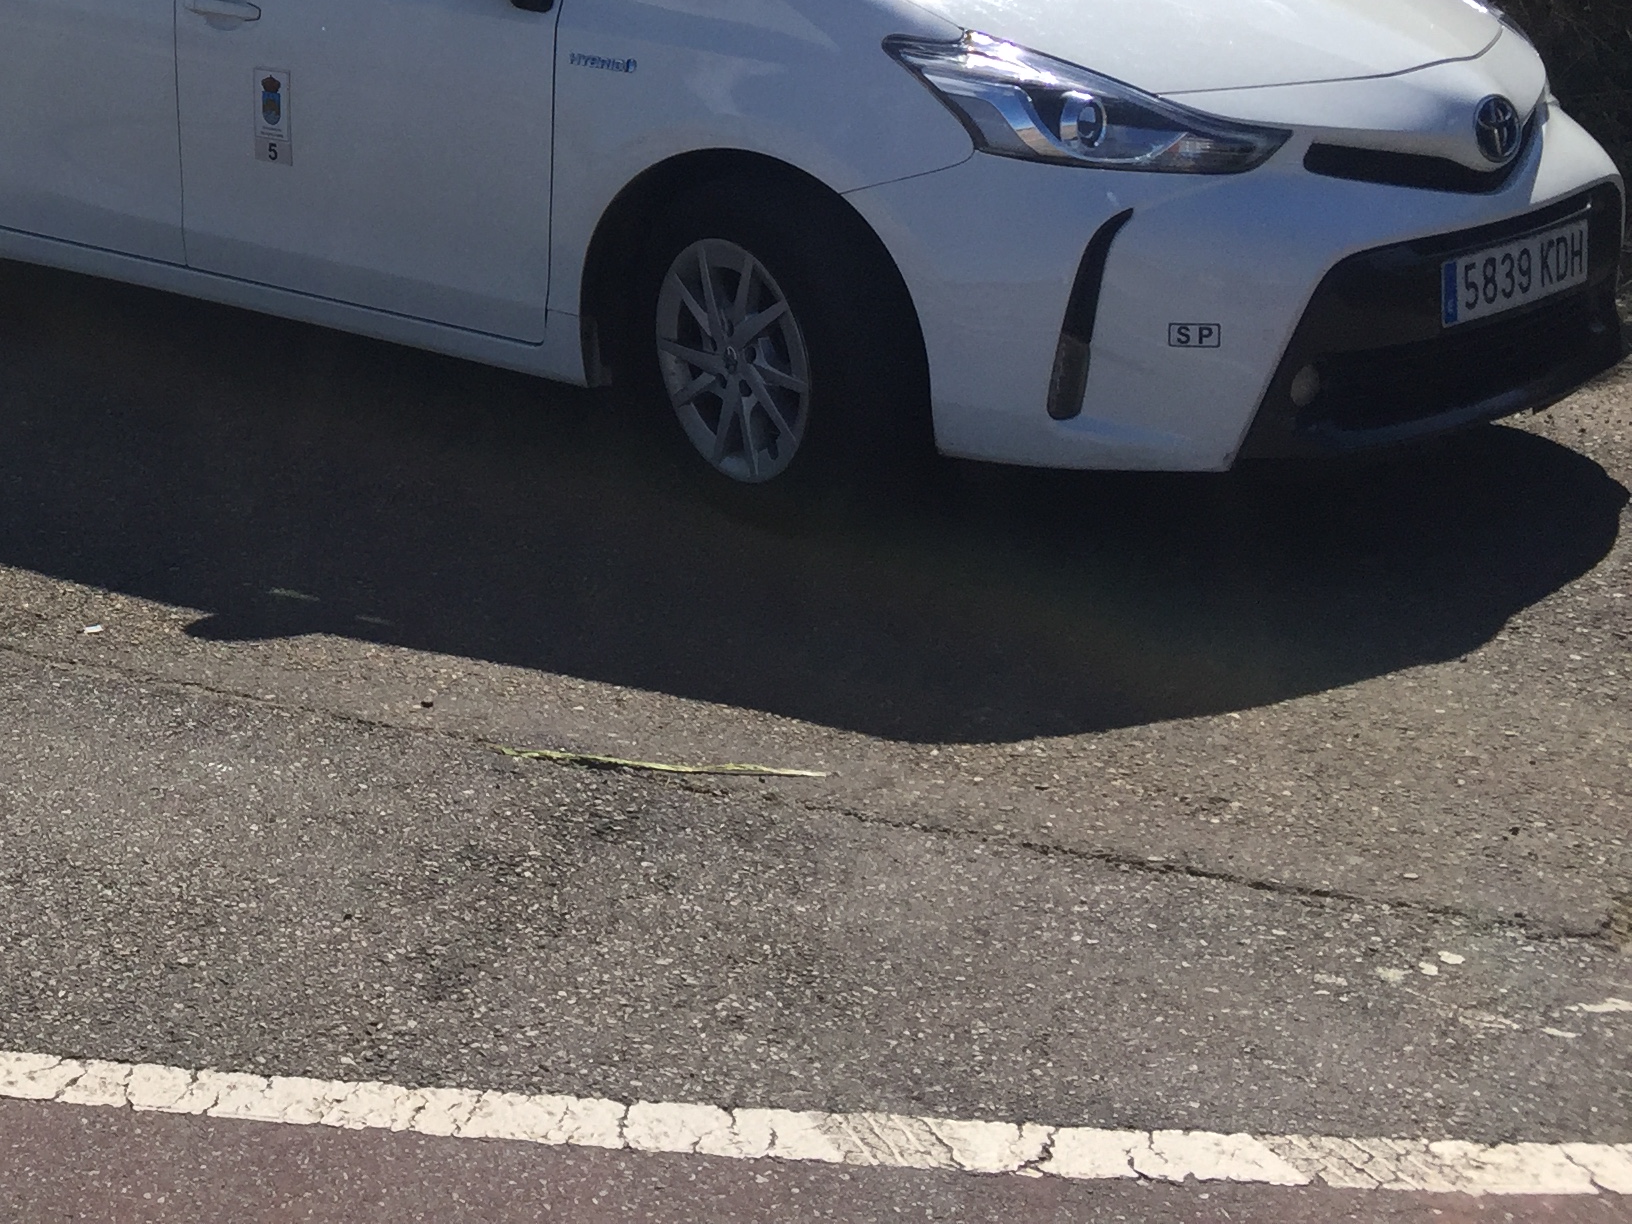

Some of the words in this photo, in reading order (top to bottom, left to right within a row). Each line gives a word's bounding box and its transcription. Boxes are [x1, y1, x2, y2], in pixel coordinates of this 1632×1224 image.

[268, 142, 278, 161] 5
[1464, 247, 1532, 311] 5839
[1540, 229, 1584, 288] KDH
